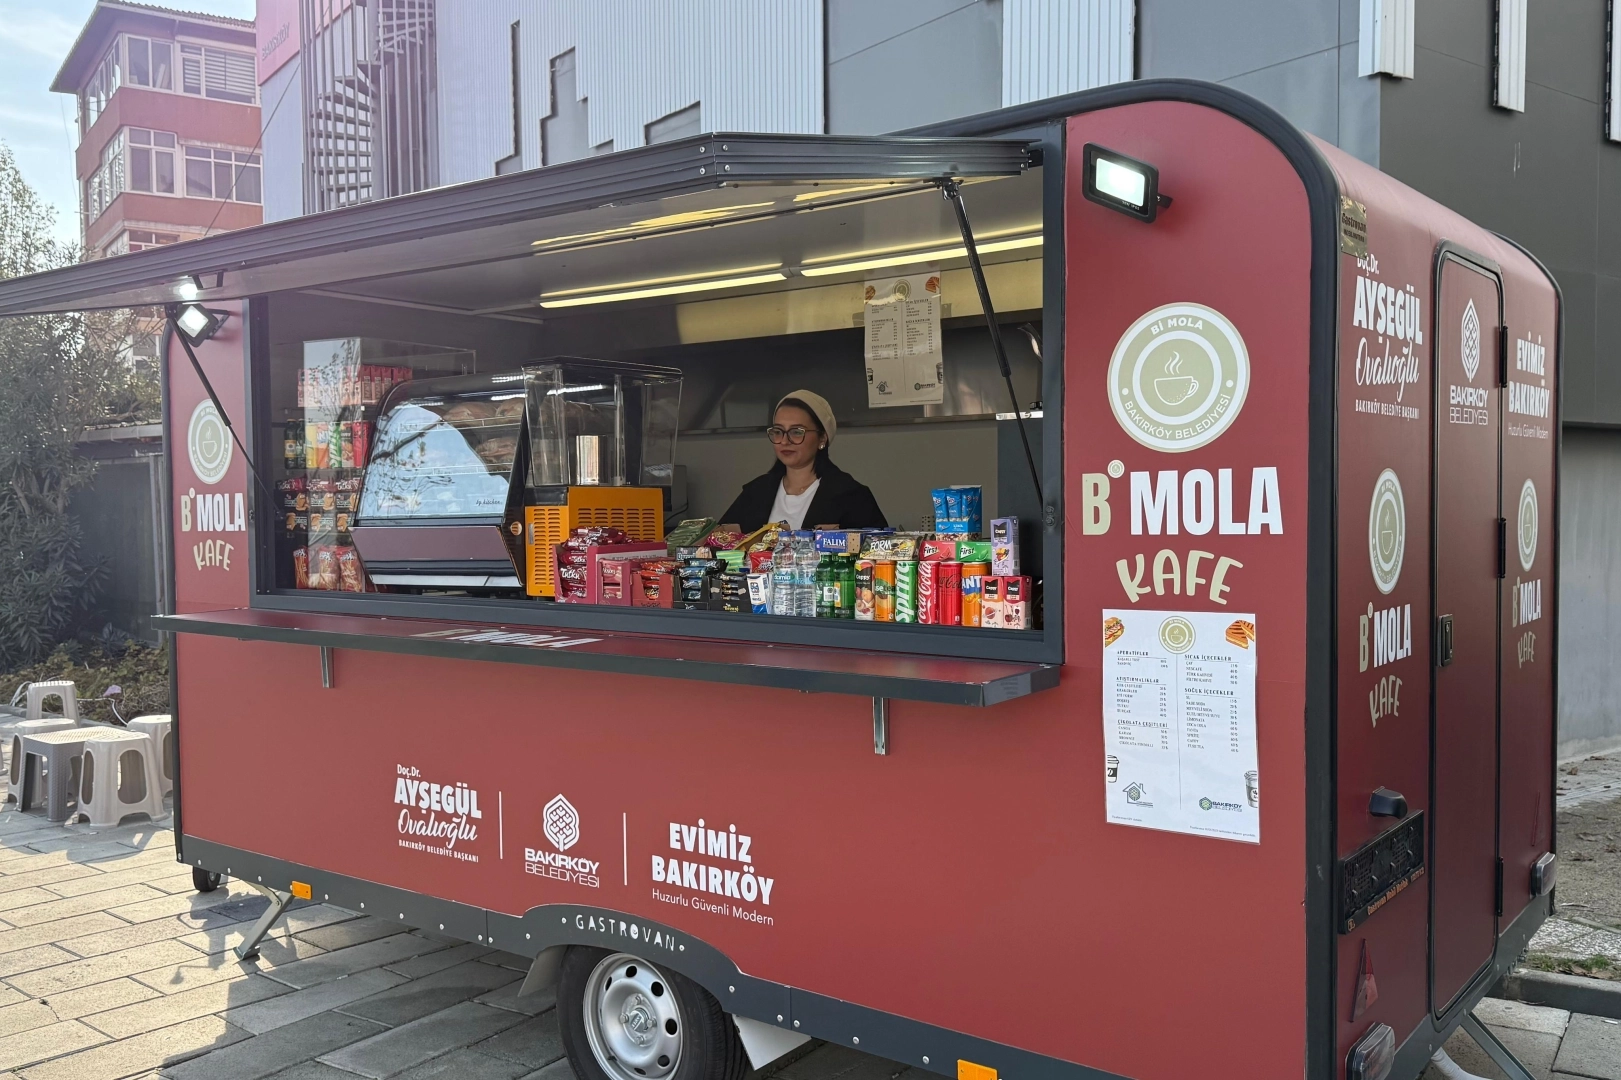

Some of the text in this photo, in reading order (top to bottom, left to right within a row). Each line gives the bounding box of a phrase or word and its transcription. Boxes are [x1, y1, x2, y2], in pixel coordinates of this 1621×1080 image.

[1150, 317, 1203, 335] Bİ MOLA
[1353, 275, 1423, 345] AYŞEGÜL
[1356, 337, 1420, 402] Ovalıoğlu
[1516, 330, 1546, 376] EVİMİZ
[1450, 384, 1488, 408] BAKIRKÖY
[1508, 378, 1550, 418] BAKIRKÖY
[1124, 394, 1231, 440] BAKIRKÖY BELEDİYESİ
[196, 492, 246, 532] MOLA
[1130, 466, 1284, 536] MOLA
[193, 538, 234, 572] KAFE
[823, 538, 846, 546] FALIM
[870, 540, 892, 552] FORM
[924, 543, 938, 554] First
[960, 544, 974, 555] First
[895, 561, 914, 623] Sprite
[1116, 548, 1244, 605] KAFE
[1520, 579, 1541, 626] MOLA
[1374, 604, 1412, 668] MOLA
[1518, 631, 1536, 669] KAFE
[1369, 674, 1402, 728] KAFE
[394, 777, 482, 819] AYŞEGÜL
[398, 809, 478, 849] Ovalıoğlu
[670, 818, 752, 864] EVİMİZ
[398, 839, 479, 863] BAKIRKÖY BELEDİYE BAŞKANI
[525, 848, 599, 874] BAKIRKÖY
[652, 855, 774, 905] BAKIRKÖY
[652, 888, 774, 926] Huzurlu Güvenli Modern
[575, 914, 675, 952] GASTROVAN
